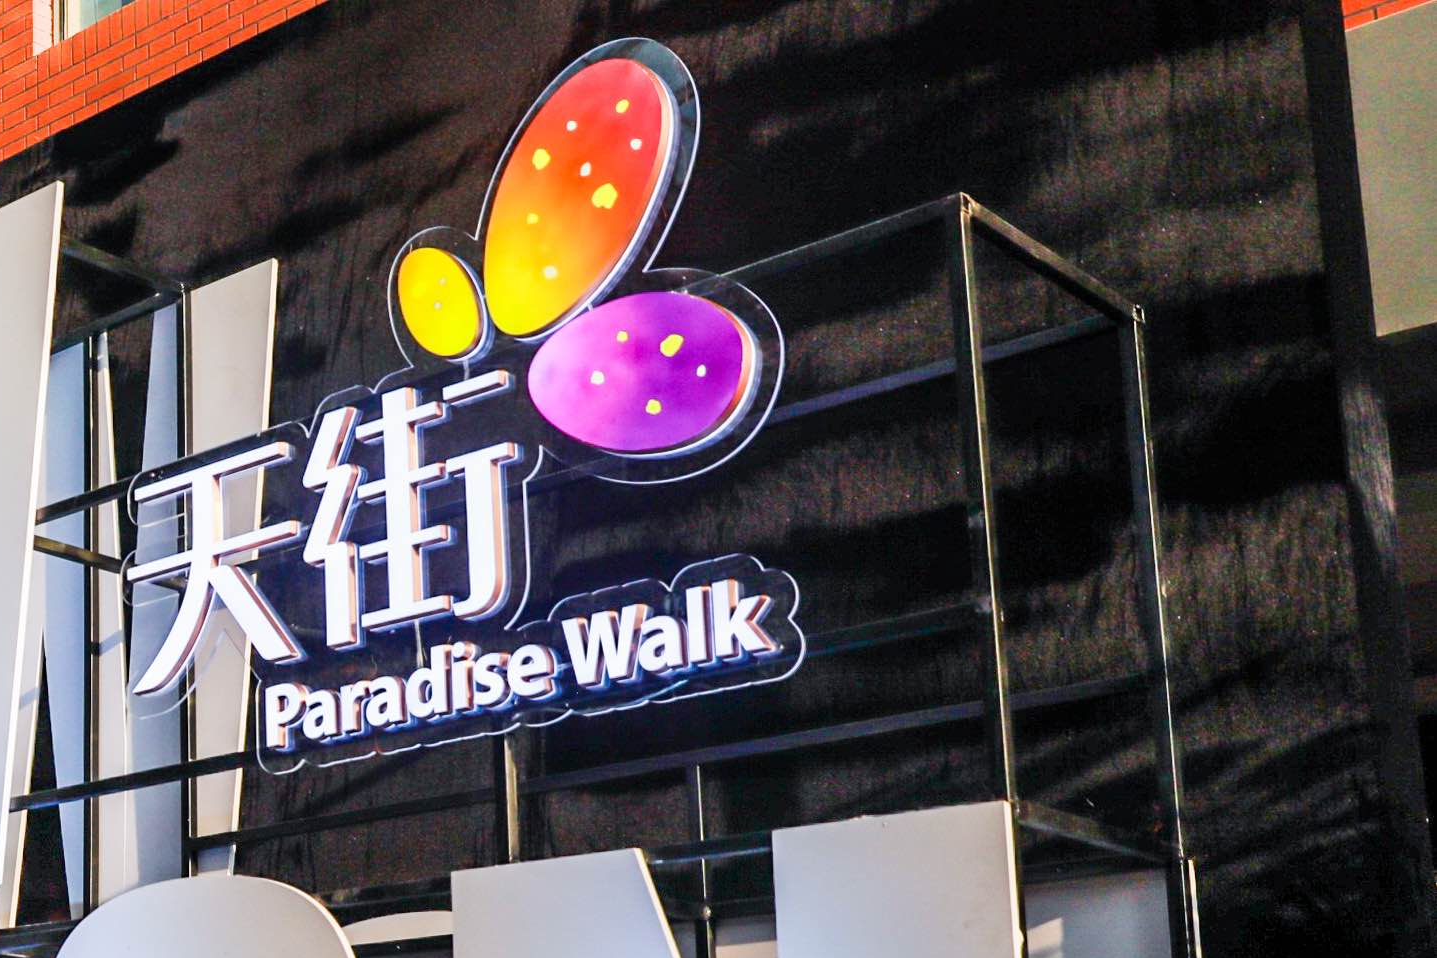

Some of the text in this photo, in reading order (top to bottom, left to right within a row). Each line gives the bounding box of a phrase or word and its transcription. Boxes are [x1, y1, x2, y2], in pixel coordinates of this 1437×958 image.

[127, 369, 522, 695] 天街
[263, 577, 778, 751] Paradise Walk
